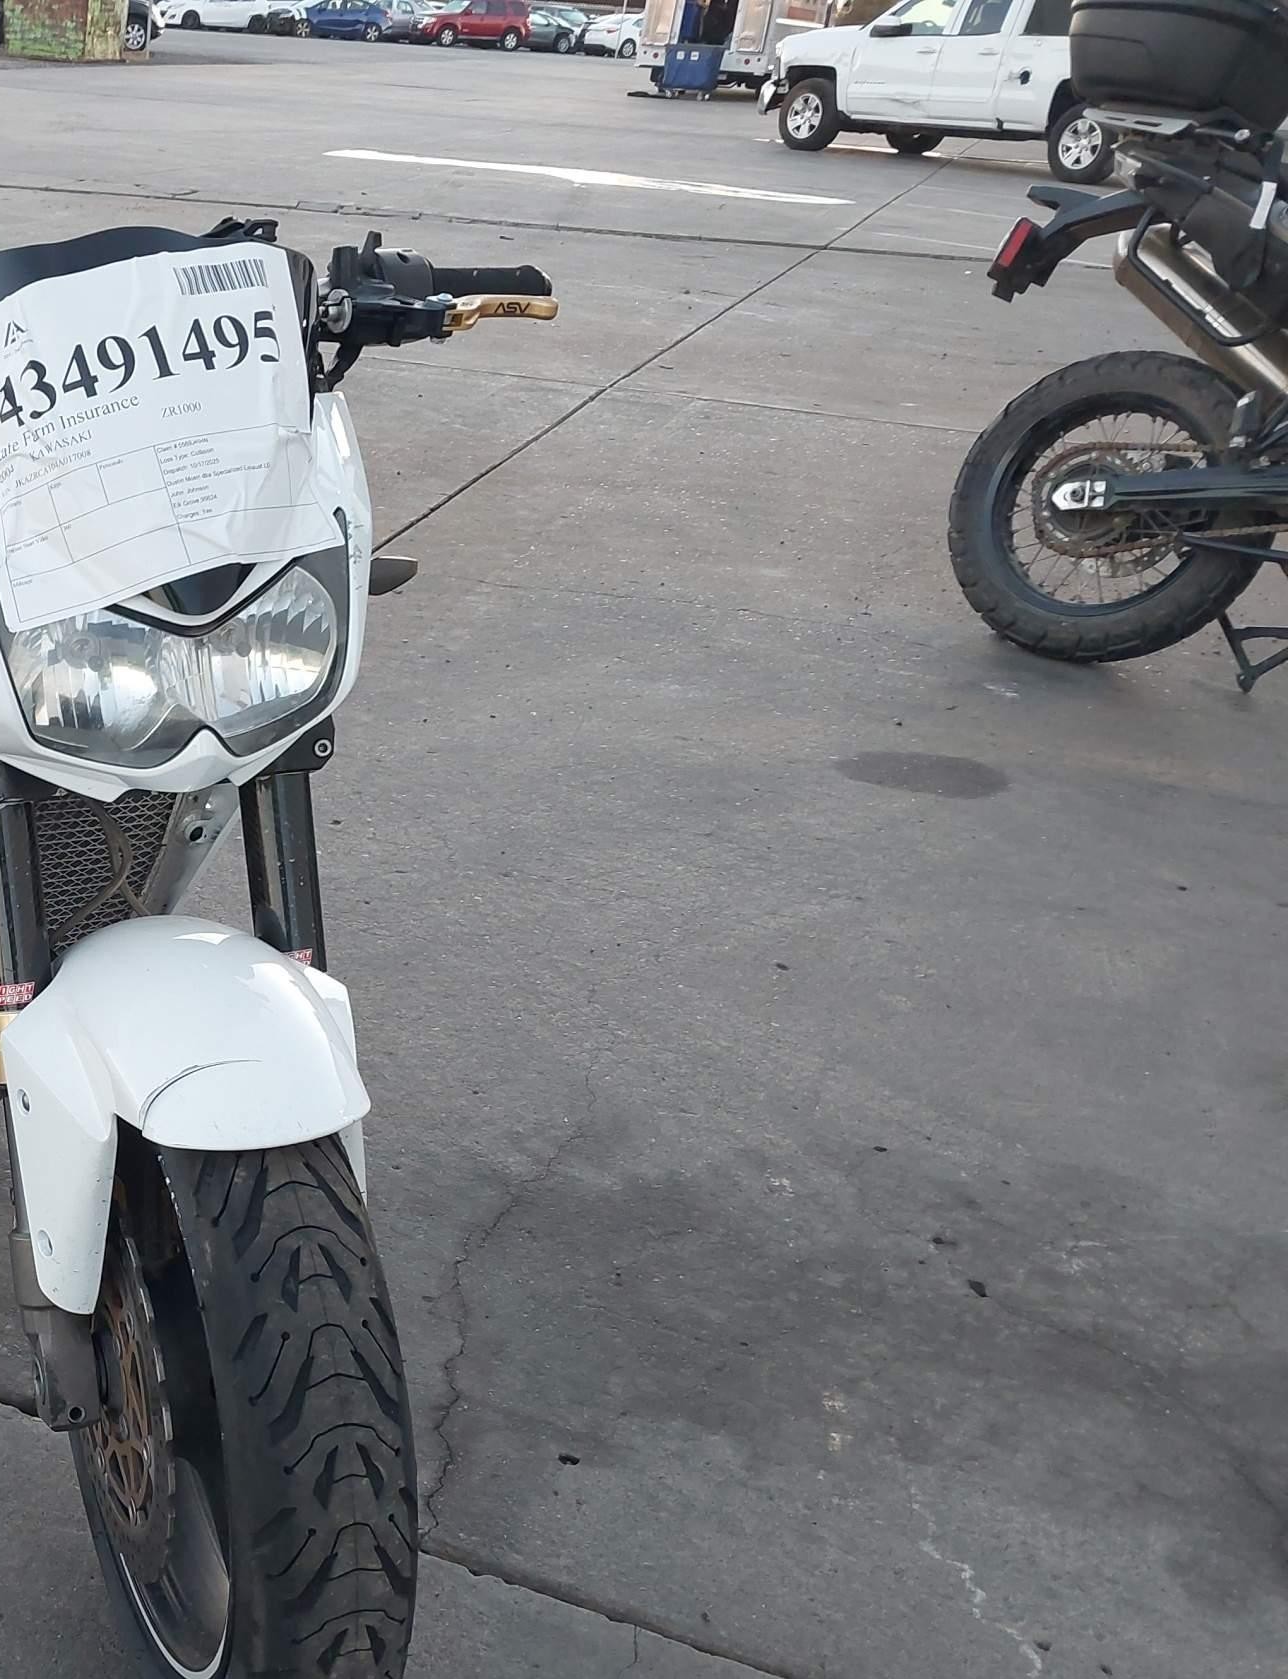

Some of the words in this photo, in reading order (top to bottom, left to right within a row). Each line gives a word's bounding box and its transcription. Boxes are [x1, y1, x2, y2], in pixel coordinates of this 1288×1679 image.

[494, 302, 530, 314] ASV
[22, 421, 56, 447] Farm
[59, 395, 140, 430] Insurance
[29, 429, 93, 461] KAWASAKI
[161, 401, 202, 419] ZR1000
